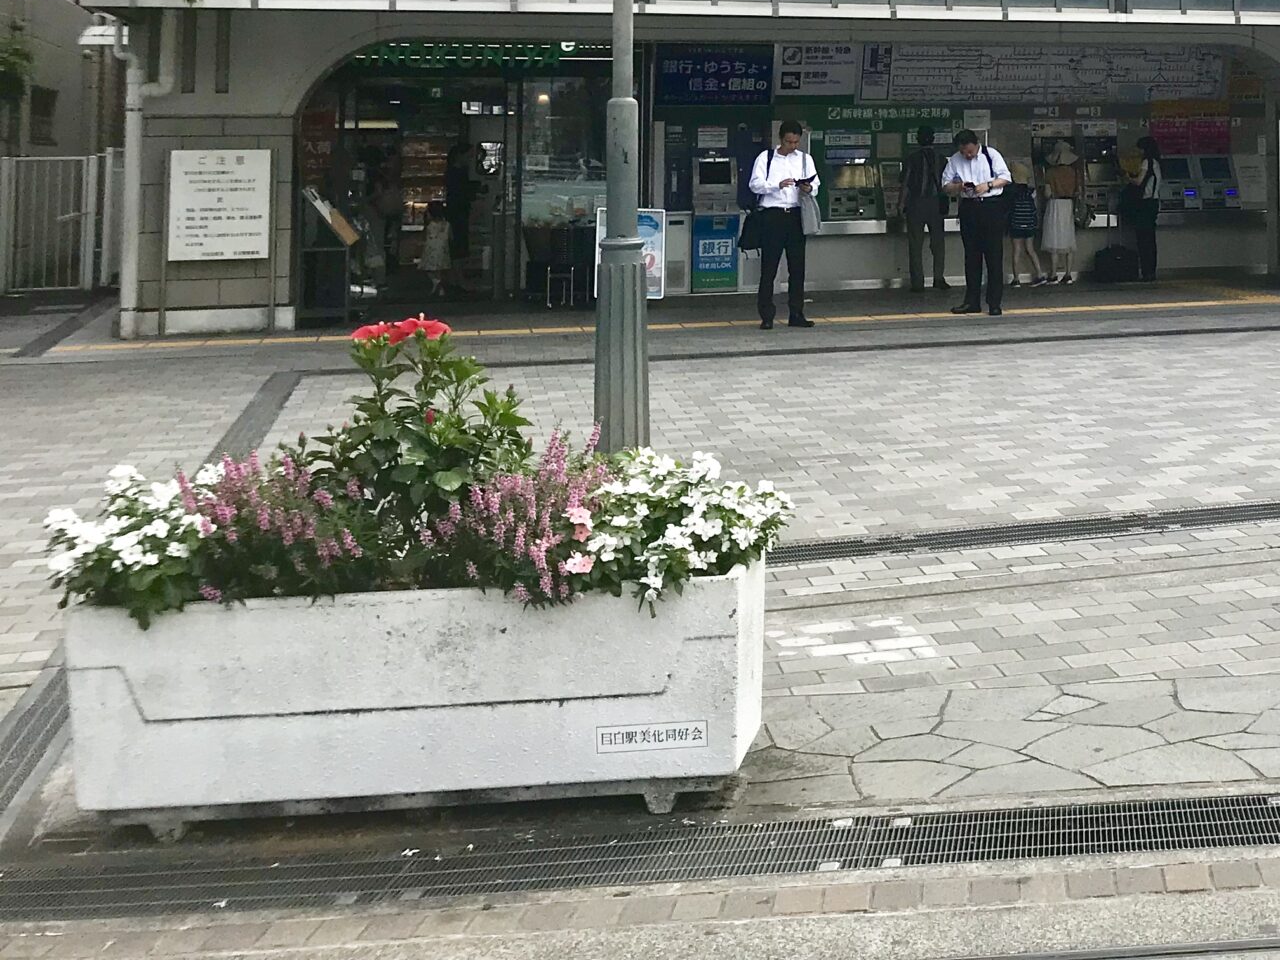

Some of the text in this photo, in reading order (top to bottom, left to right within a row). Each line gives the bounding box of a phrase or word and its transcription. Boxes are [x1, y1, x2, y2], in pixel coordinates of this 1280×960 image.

[702, 241, 729, 254] 銀行
[601, 727, 703, 745] 目白駅美化同好会
